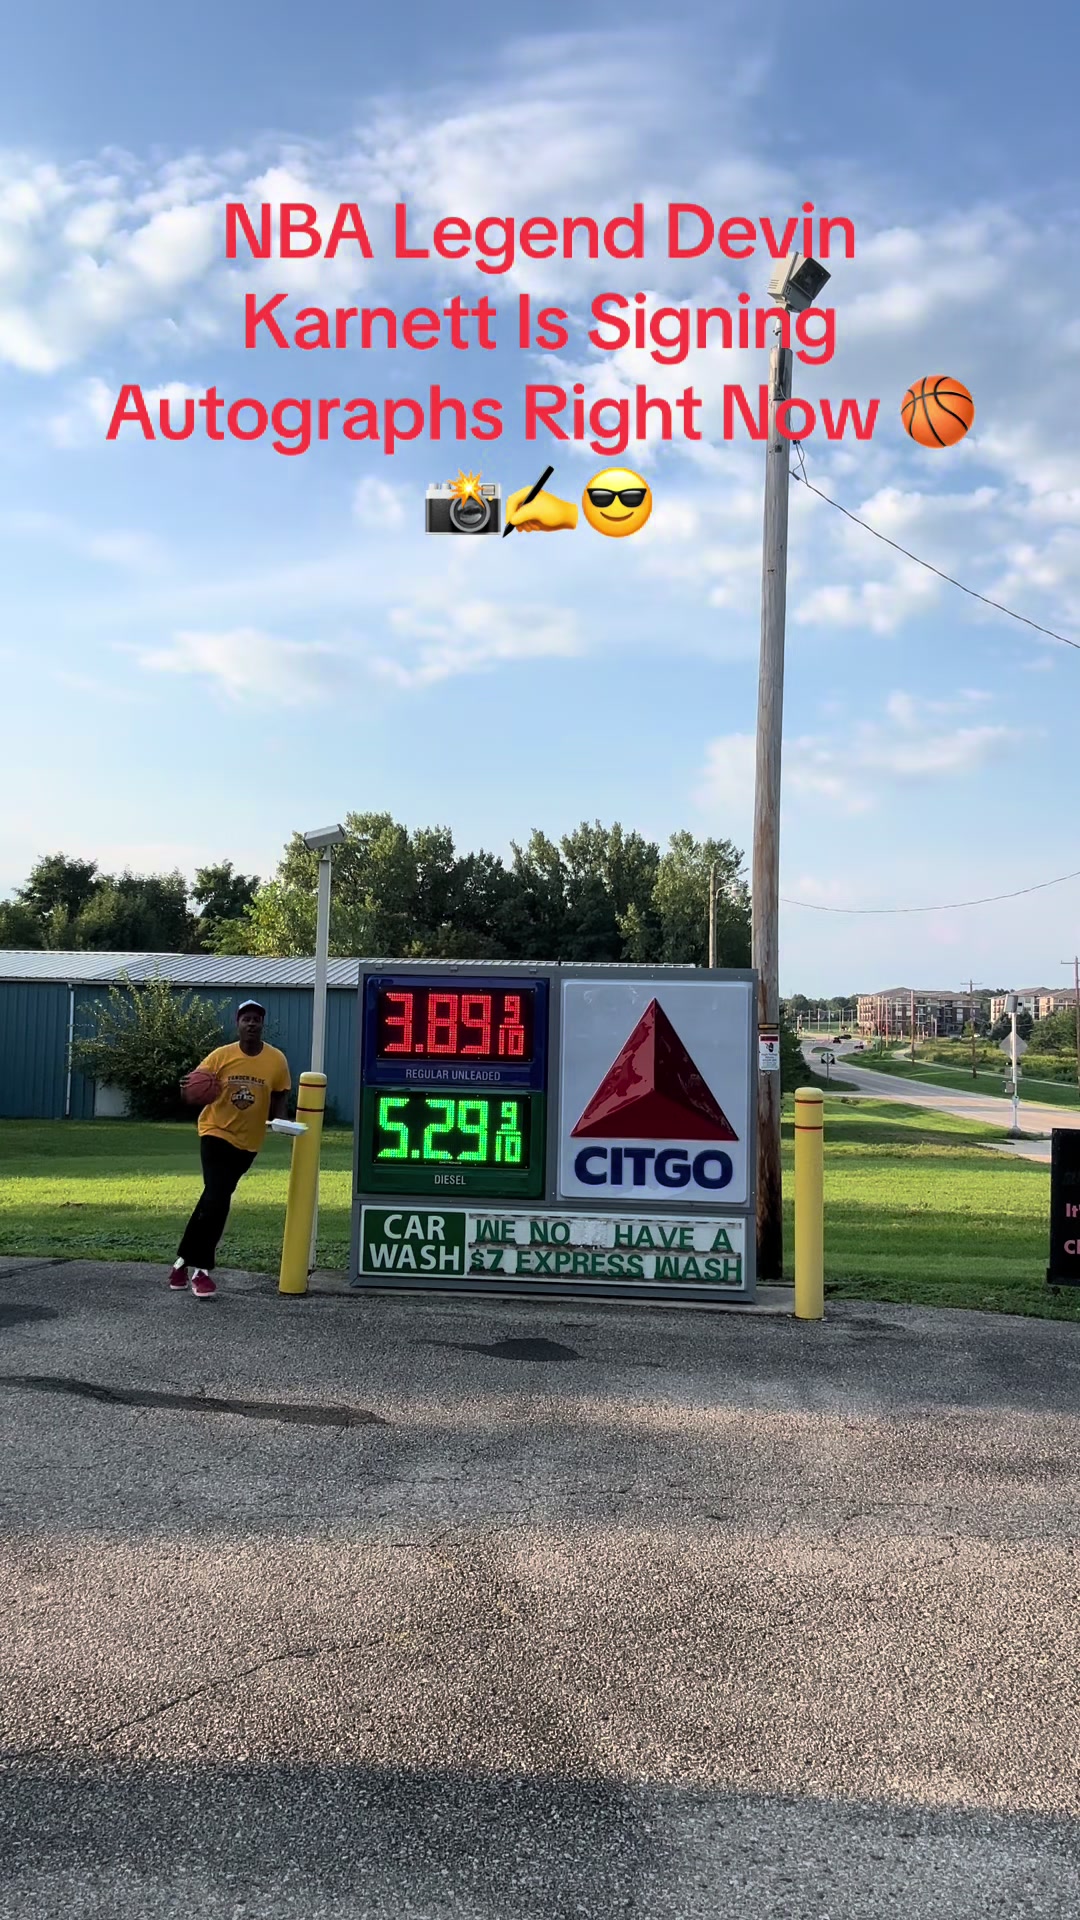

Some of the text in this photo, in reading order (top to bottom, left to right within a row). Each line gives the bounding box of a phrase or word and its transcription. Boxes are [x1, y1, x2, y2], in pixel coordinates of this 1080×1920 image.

[384, 993, 491, 1054] 3.89
[405, 1068, 501, 1082] REGULAR UNLEADED
[377, 1097, 488, 1161] 5.29
[434, 1174, 466, 1185] DIESEL
[574, 1145, 733, 1190] CITGO
[383, 1214, 446, 1241] CAR
[476, 1219, 733, 1252] WE NO HAVE A
[369, 1243, 460, 1271] WASH
[470, 1249, 742, 1282] $7 EXPRESS WASH
